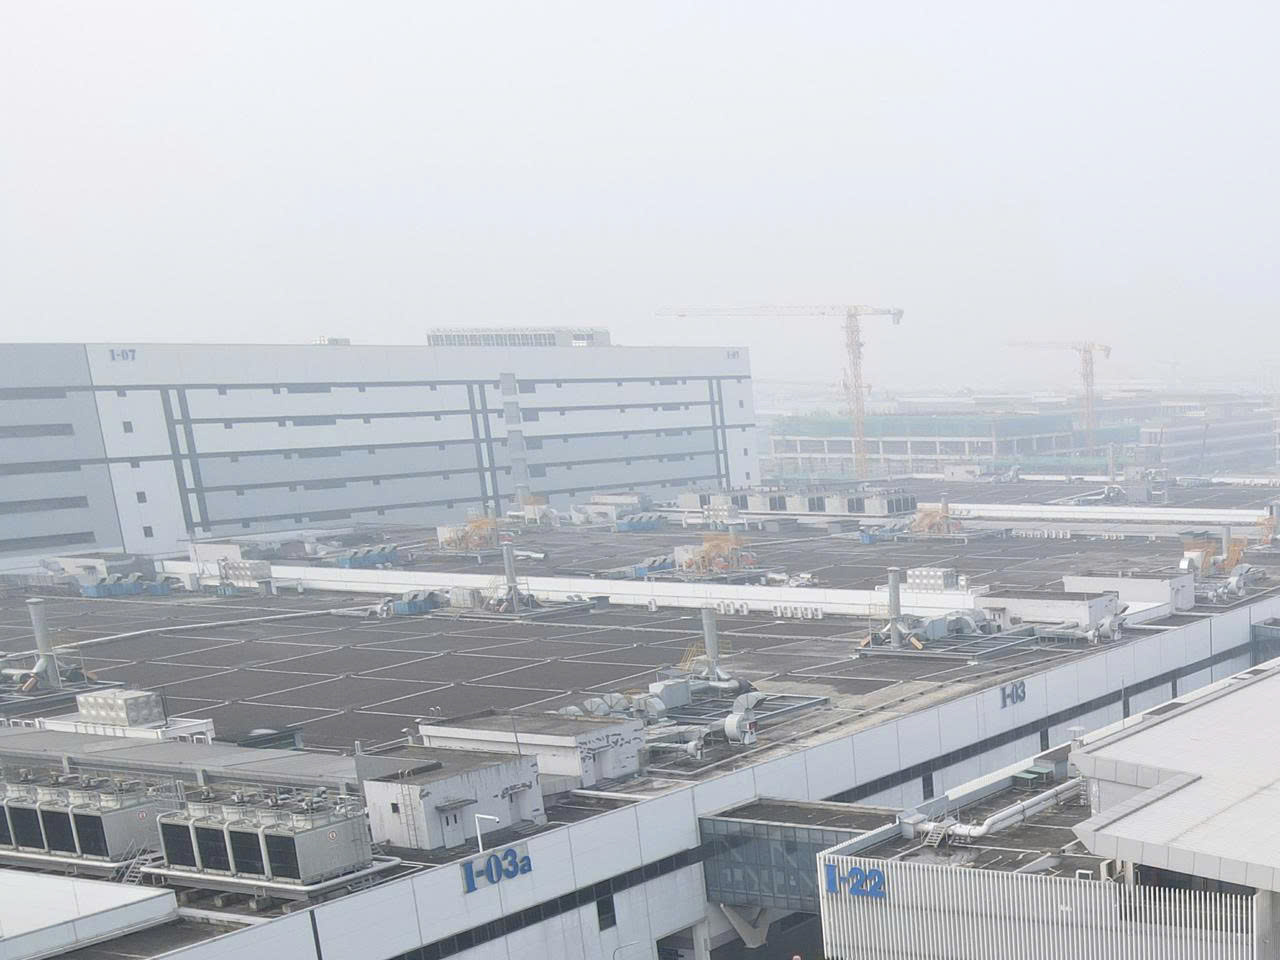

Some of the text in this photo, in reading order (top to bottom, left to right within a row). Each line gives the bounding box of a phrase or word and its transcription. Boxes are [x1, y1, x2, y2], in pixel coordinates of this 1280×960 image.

[109, 349, 136, 361] I-07
[1000, 680, 1026, 709] I-03
[461, 848, 533, 894] I-03a
[824, 864, 886, 897] I-22
